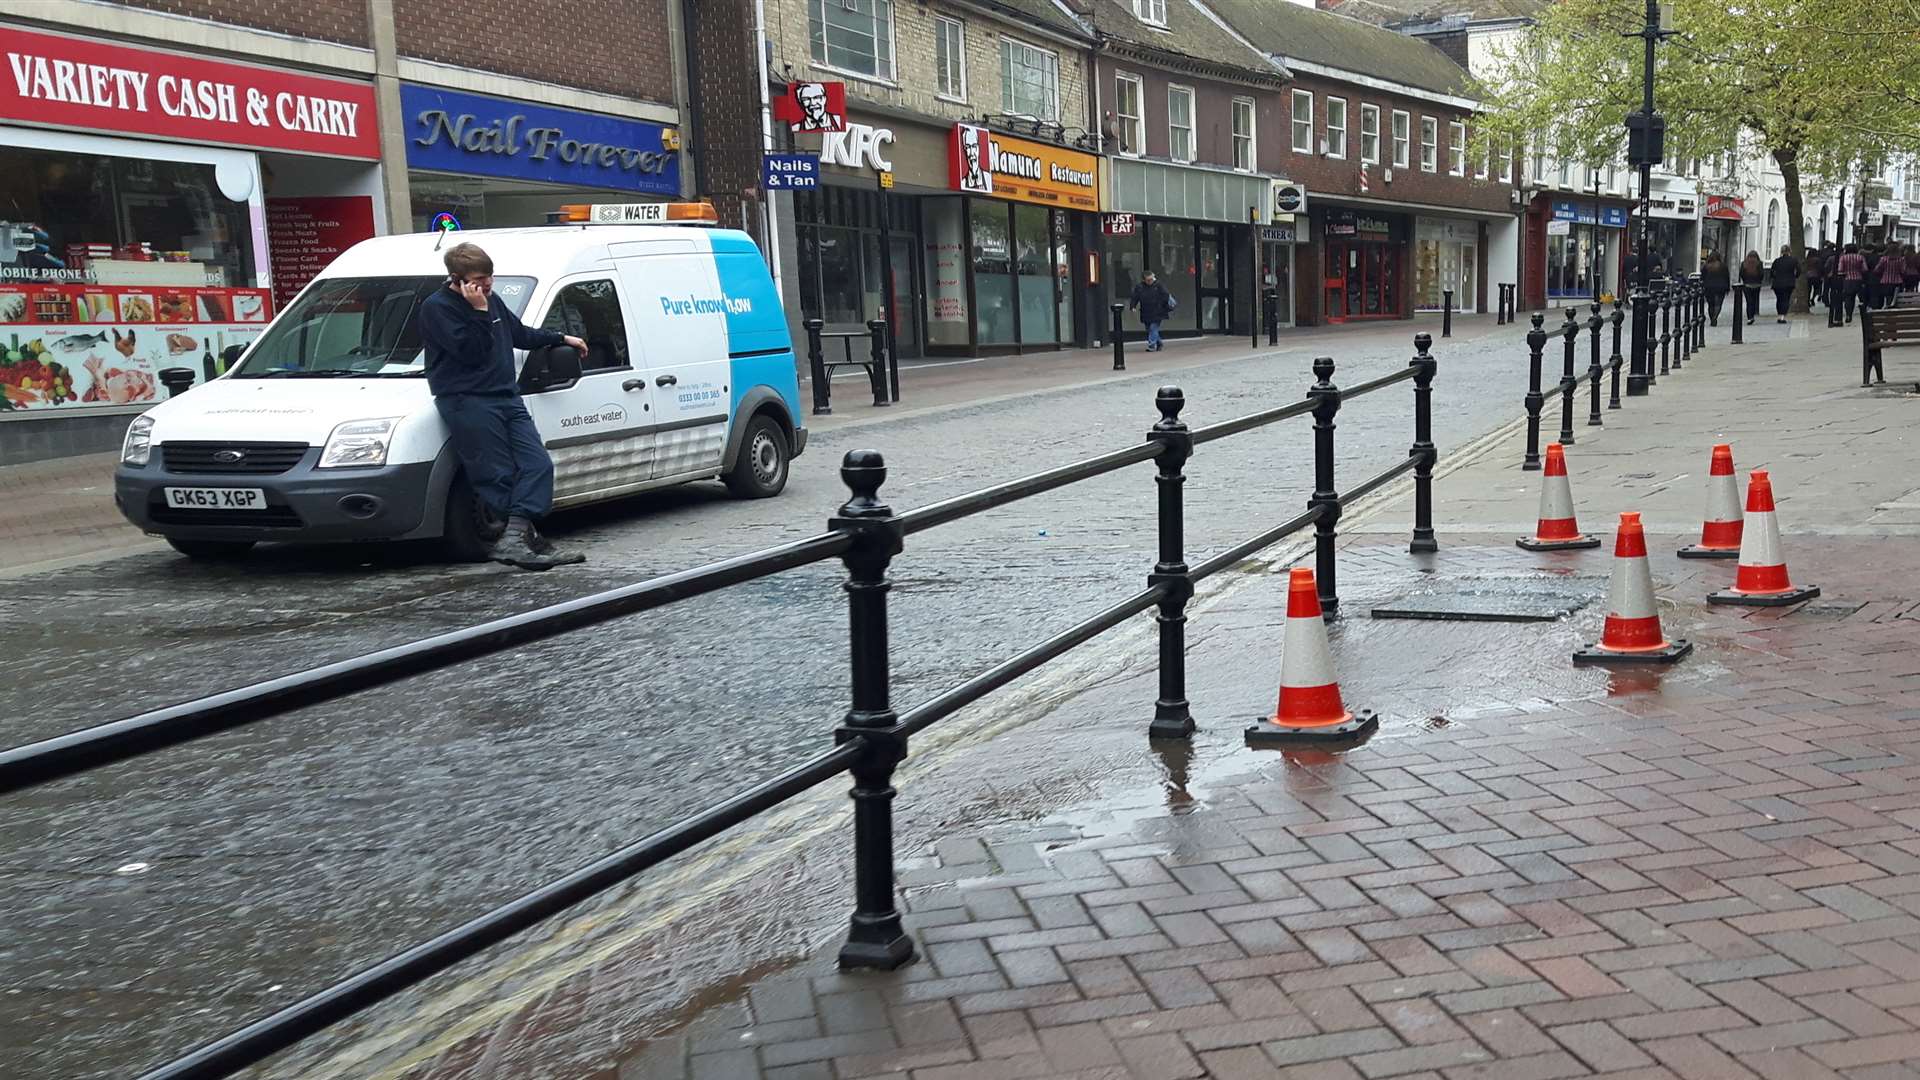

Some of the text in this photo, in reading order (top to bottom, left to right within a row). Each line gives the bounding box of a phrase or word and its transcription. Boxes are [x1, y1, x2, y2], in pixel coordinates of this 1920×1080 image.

[7, 53, 358, 138] VARIETY CASH & CARRY
[414, 110, 672, 175] Nail Forever
[820, 122, 892, 172] KFC
[769, 160, 812, 172] Nails
[989, 140, 1093, 187] Namuna Restaurant
[768, 174, 815, 186] & Tan
[625, 205, 660, 220] WATER
[1104, 213, 1132, 225] JUST
[318, 220, 340, 228] Fruits
[1111, 223, 1132, 233] EAT
[0, 266, 38, 279] OBILE
[42, 268, 81, 280] PHONE
[660, 297, 693, 316] Pure
[560, 411, 622, 427] south east water
[172, 489, 256, 507] GK63 XGP
